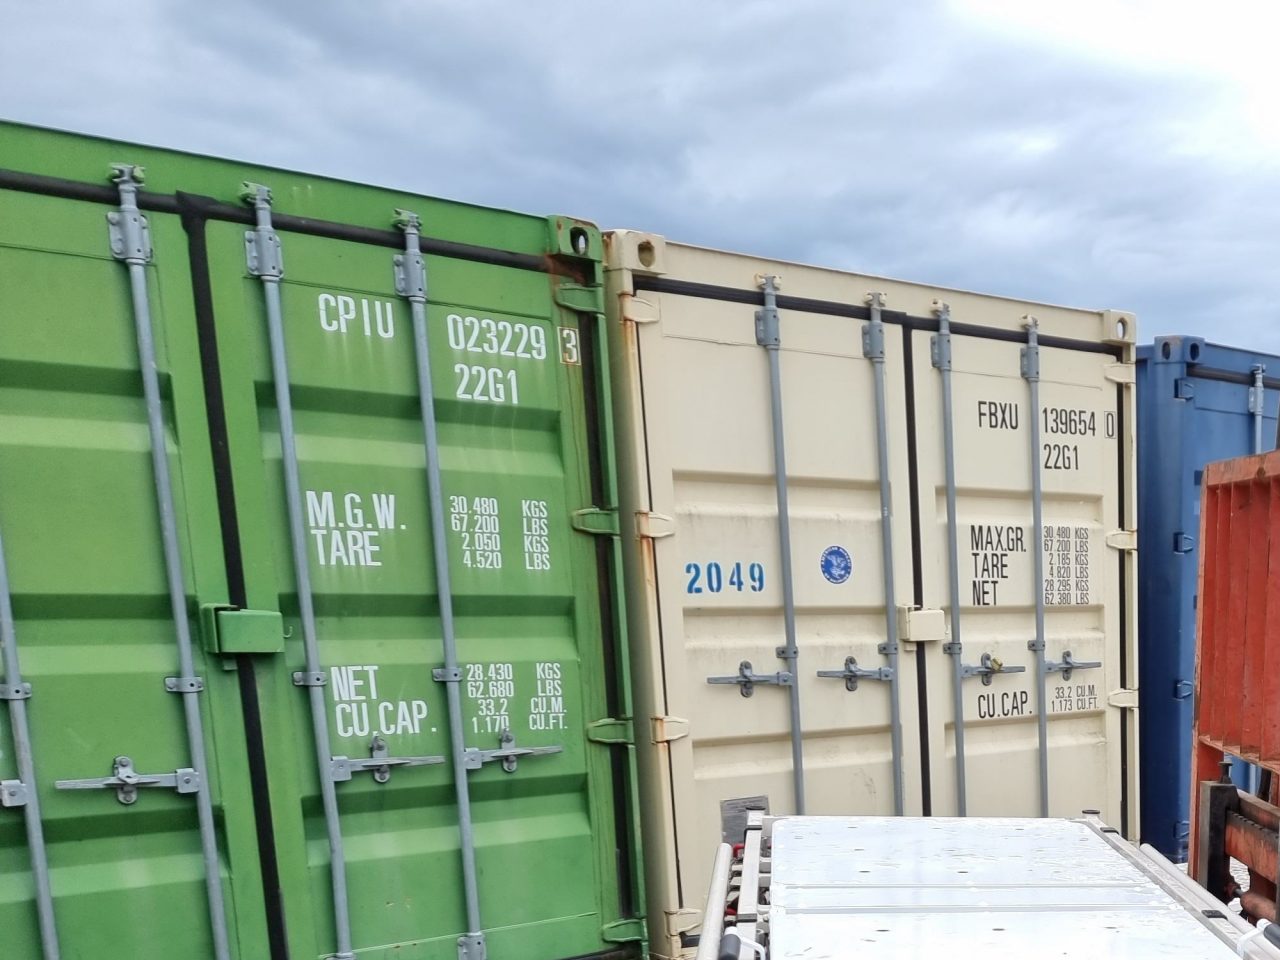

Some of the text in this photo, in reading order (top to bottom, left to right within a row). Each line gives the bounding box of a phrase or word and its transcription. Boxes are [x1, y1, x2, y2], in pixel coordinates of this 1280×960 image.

[318, 293, 578, 363] CPIU 023229 3
[454, 363, 518, 404] 22G1
[978, 400, 1019, 430] FBXU
[1042, 407, 1096, 437] 139654
[1043, 443, 1079, 470] 22G1
[306, 490, 407, 530] M.G.W.
[450, 495, 548, 518] 30.480 KGS
[451, 514, 549, 536] 67.200 LBS
[1043, 525, 1089, 540] 30.480 KGS
[311, 529, 382, 566] TARE
[462, 532, 550, 553] 2.050 KGS
[970, 525, 1027, 552] MAX.GR.
[1043, 539, 1089, 553] 67.200 LBS
[463, 550, 551, 570] 4.520 LBS
[971, 553, 1009, 578] TARE
[1049, 552, 1089, 566] 2.185 KGS
[685, 561, 765, 594] 2049
[1049, 565, 1089, 579] 4.820 LBS
[972, 580, 999, 606] NET
[1044, 579, 1089, 592] 28.295 KGS
[1044, 592, 1090, 605] 62.380 LBS
[466, 662, 561, 681] 28.430 KGS
[330, 665, 379, 701] NET
[467, 679, 562, 698] 62.680 LBS
[1055, 686, 1072, 699] 33.2
[478, 697, 567, 716] 33.2 CU.M.
[977, 690, 1033, 719] CU.CAP.
[1051, 699, 1073, 712] 1.173
[335, 700, 437, 738] CU.CAP.
[472, 713, 568, 734] 1.170 CU.FT.
